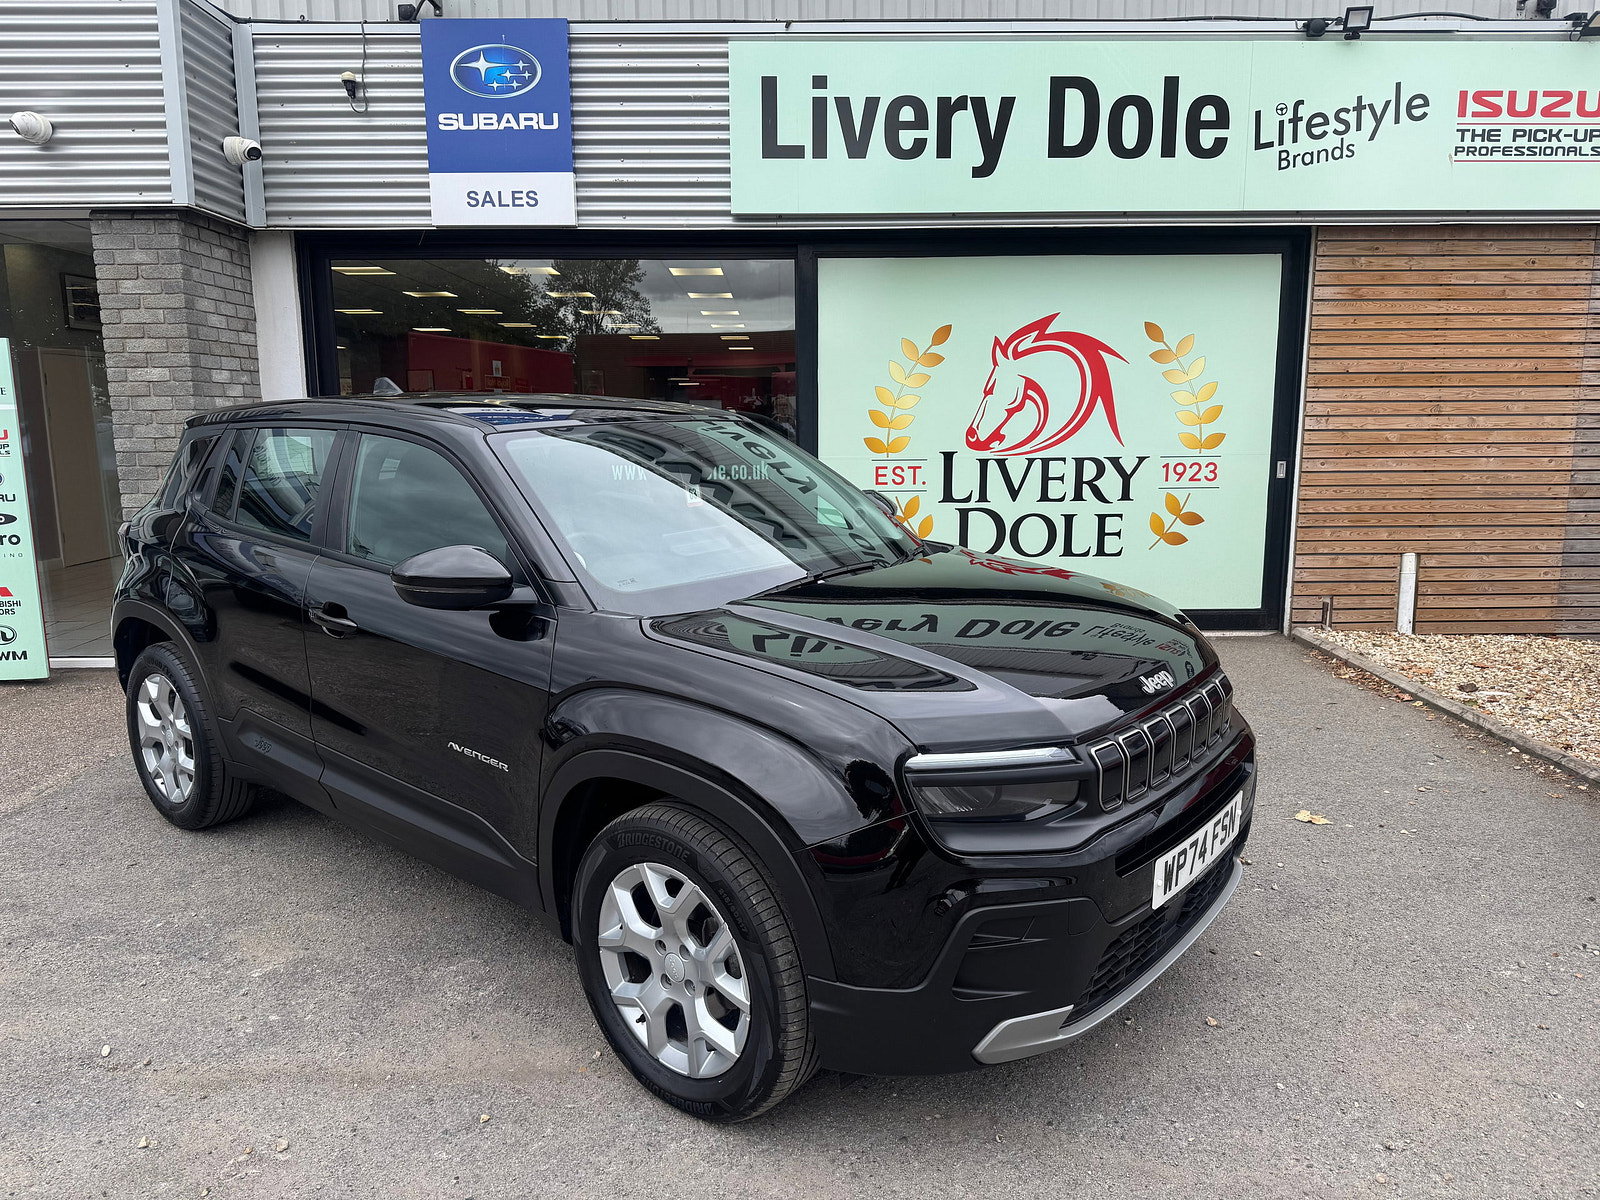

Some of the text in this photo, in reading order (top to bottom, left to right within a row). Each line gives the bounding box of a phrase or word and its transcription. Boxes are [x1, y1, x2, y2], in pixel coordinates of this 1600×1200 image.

[1253, 81, 1430, 152] Lifestyle
[1457, 90, 1600, 118] ISUZU
[438, 112, 559, 131] SUBARU
[760, 75, 1231, 179] Livery Dole
[1456, 128, 1600, 143] THE PICK-UP
[1277, 138, 1356, 171] Brands
[1454, 146, 1600, 157] PROFESSIONALS
[466, 189, 539, 209] SALES
[874, 461, 1219, 486] EST. 1923
[938, 450, 1150, 505] LIVERY
[954, 506, 1125, 559] DOLE
[1138, 669, 1175, 695] Jeep
[447, 741, 509, 773] AVENGER
[616, 831, 691, 862] BRIDGESTONE
[1163, 801, 1238, 896] WP74 FSN
